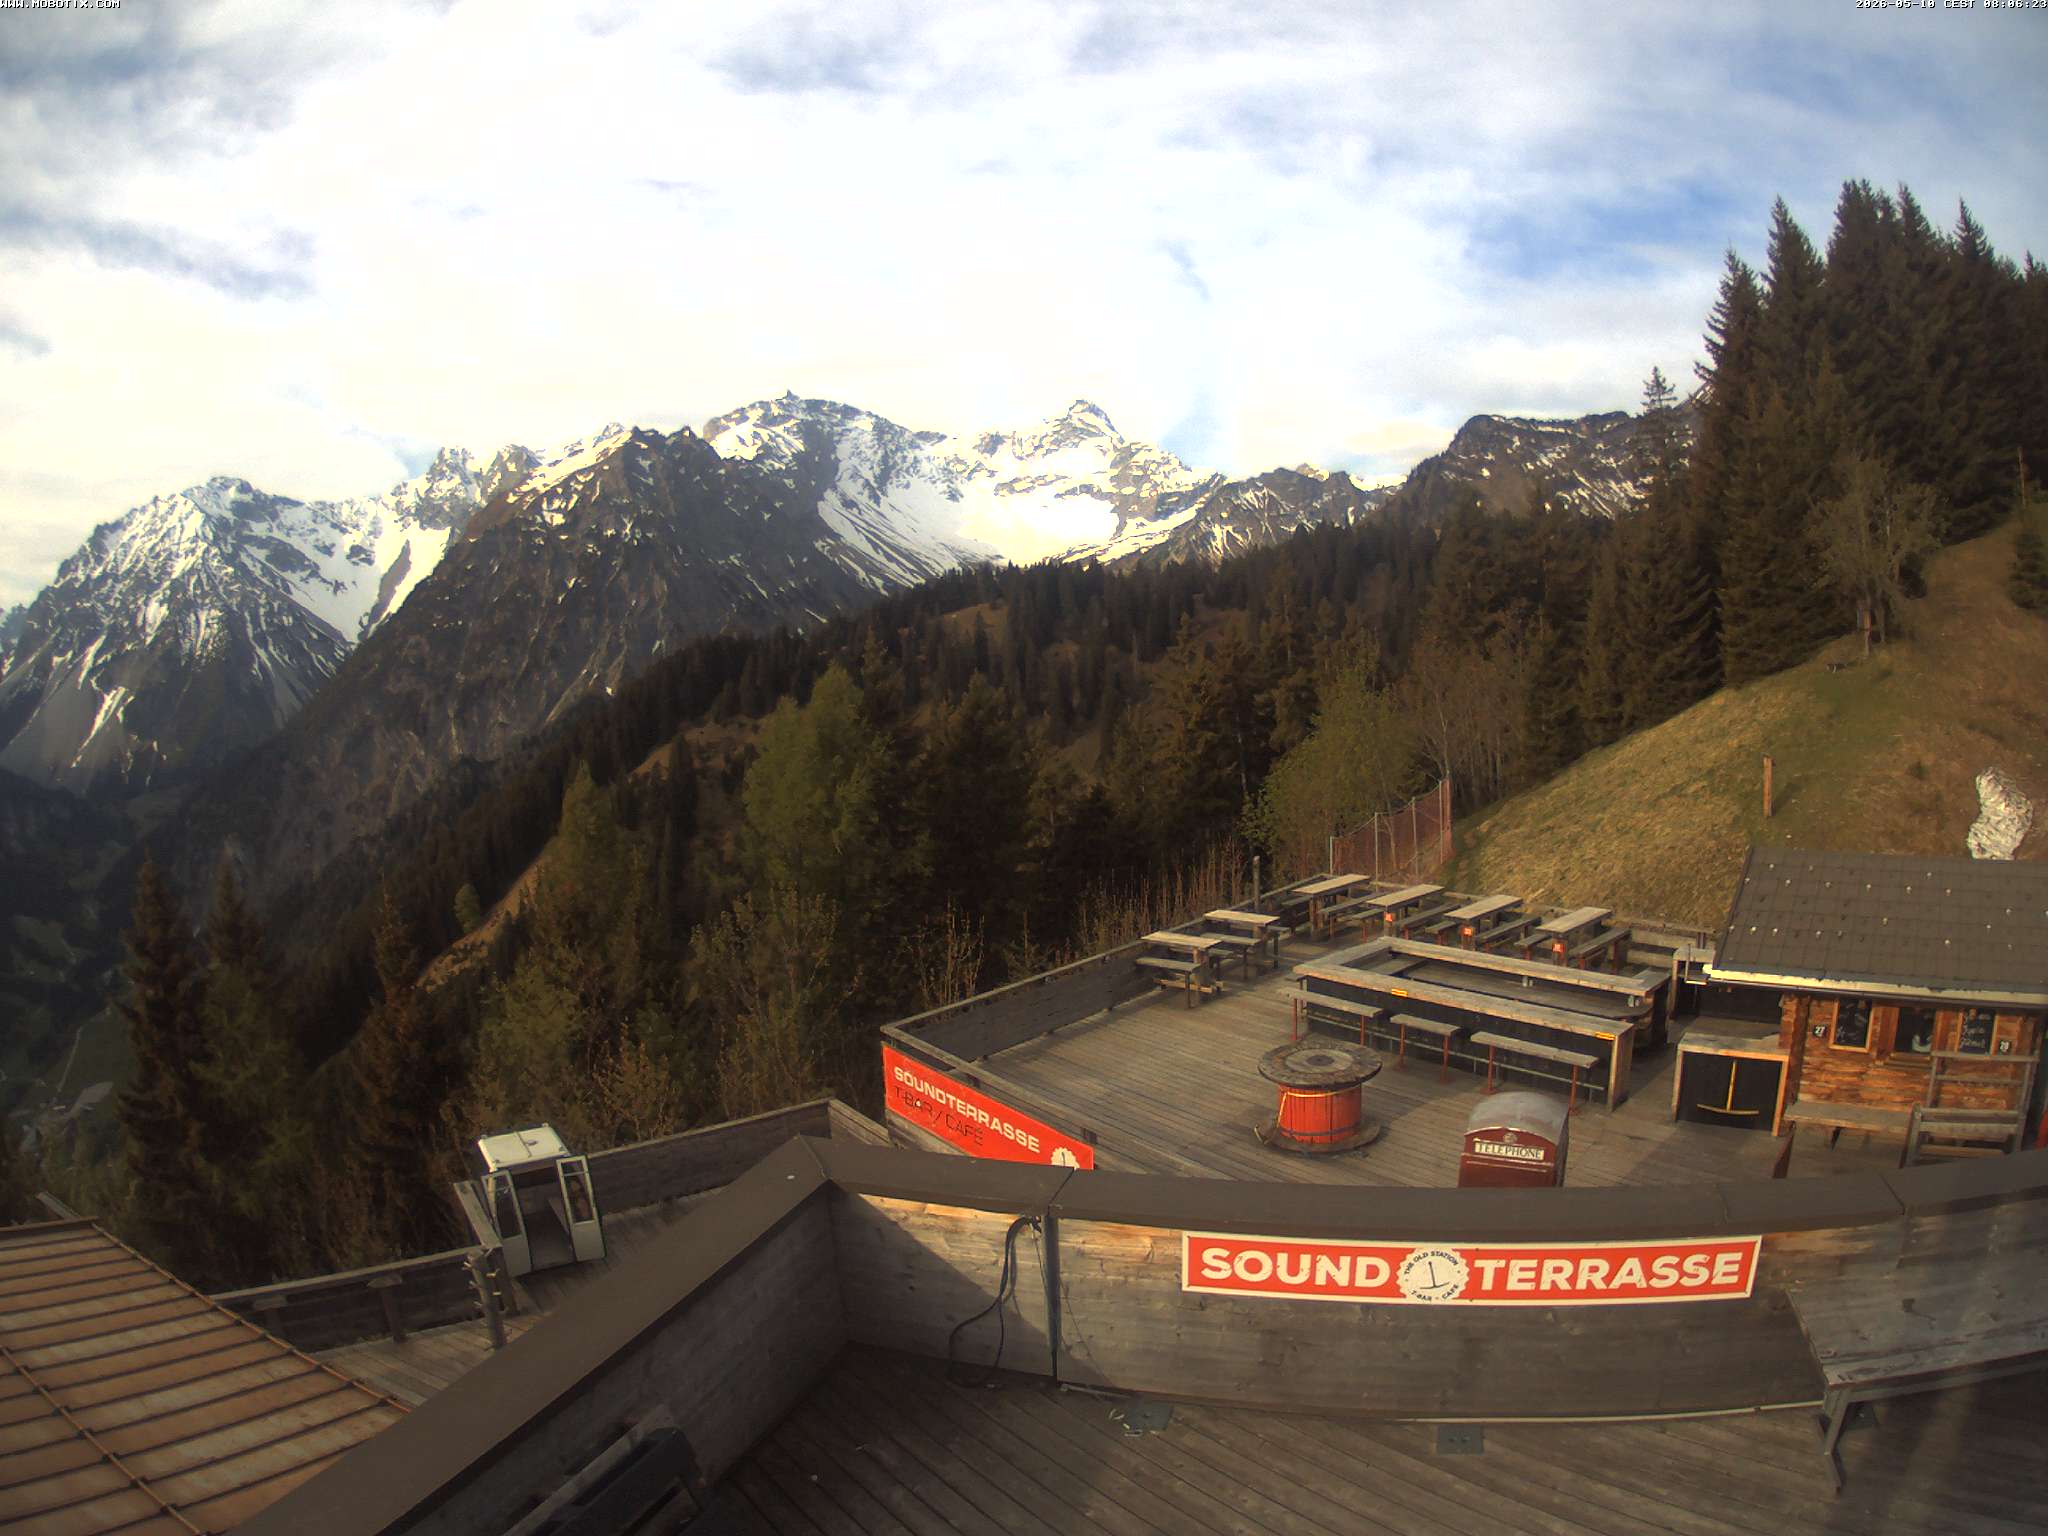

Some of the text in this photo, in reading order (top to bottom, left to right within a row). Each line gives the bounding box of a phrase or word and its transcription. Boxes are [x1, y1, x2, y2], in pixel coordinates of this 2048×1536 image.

[894, 1066, 1041, 1153] SOUNDTERRASSE
[1478, 1143, 1540, 1159] TELEPHONE
[1200, 1247, 1744, 1292] SOUND TERRASSE
[1404, 1250, 1459, 1275] THE OLD STATION
